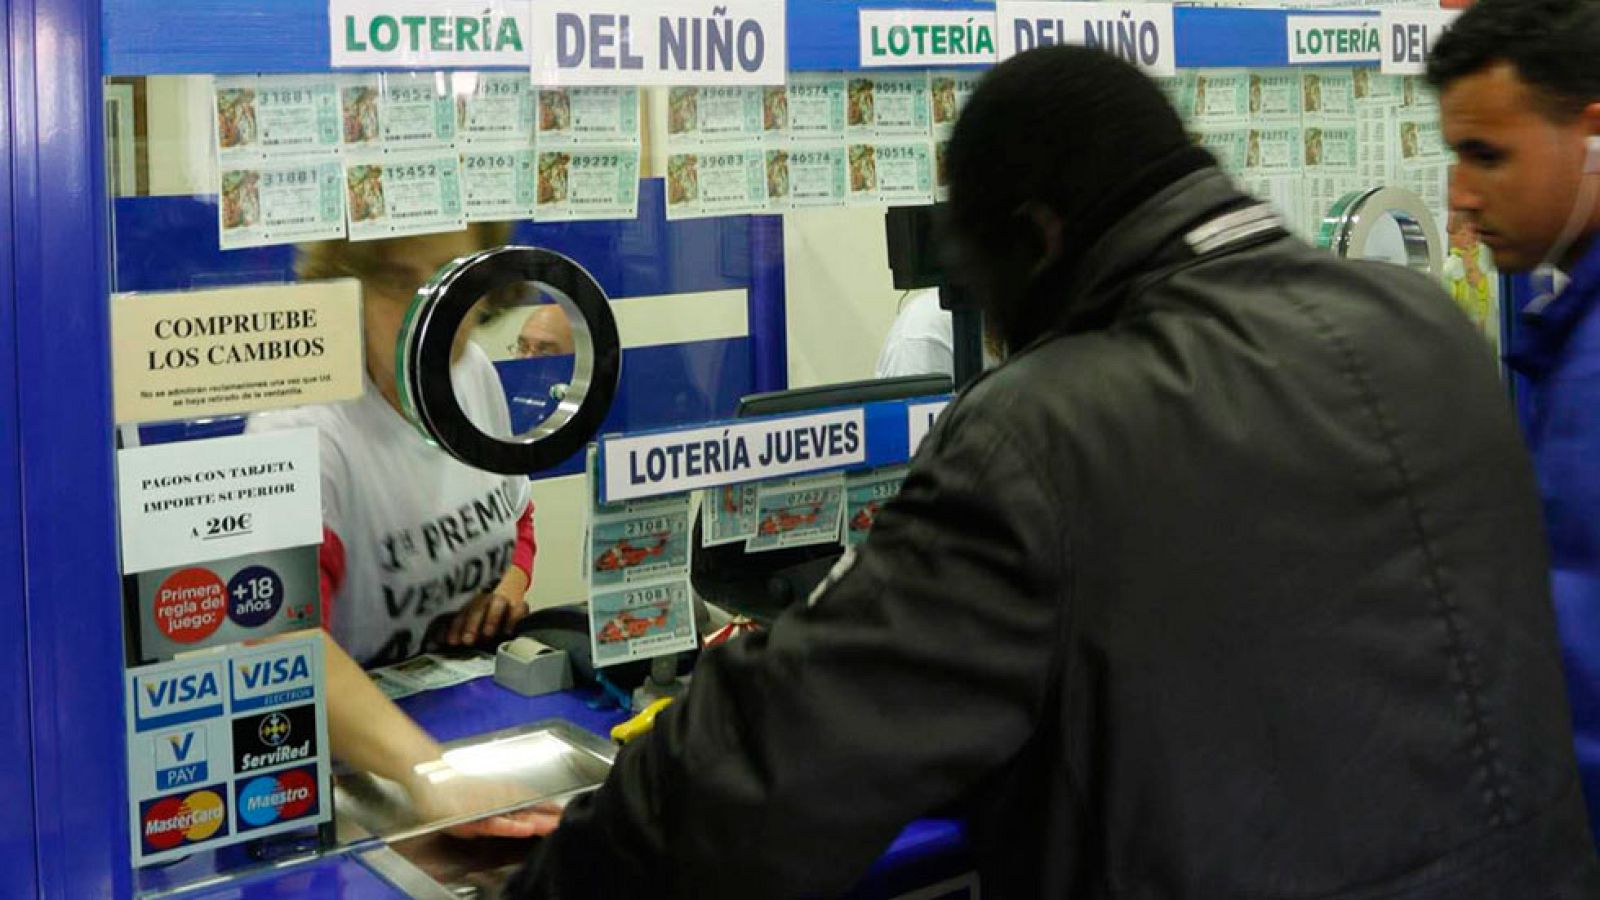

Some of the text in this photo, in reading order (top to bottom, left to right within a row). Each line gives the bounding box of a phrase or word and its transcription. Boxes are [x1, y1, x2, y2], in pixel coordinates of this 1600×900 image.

[345, 9, 523, 52] LOTERÍA
[555, 5, 766, 73] DEL NIÑO
[871, 18, 994, 57] LOTERÍA
[1083, 10, 1160, 66] NIÑO
[1296, 23, 1380, 55] LOTERÍA
[1392, 23, 1432, 63] DEL
[155, 309, 318, 340] COMPRUEBE
[148, 337, 325, 371] LOS CAMBIOS
[629, 420, 859, 486] LOTERÍA JUEVES
[141, 461, 295, 490] PAGOS CON TARJETA
[143, 483, 296, 513] IMPORTE SUPERIOR
[190, 513, 253, 538] A 20€
[160, 583, 221, 602] Primera
[232, 576, 274, 600] +18
[157, 596, 225, 618] regla del
[235, 599, 272, 615] años
[167, 614, 216, 633] juego:
[239, 654, 310, 690] VISA
[145, 671, 218, 708] VISA
[165, 731, 195, 762] V
[241, 739, 310, 771] ServiRed
[168, 767, 197, 785] PAY
[247, 785, 308, 812] Maestro
[145, 804, 223, 836] MasterCard
